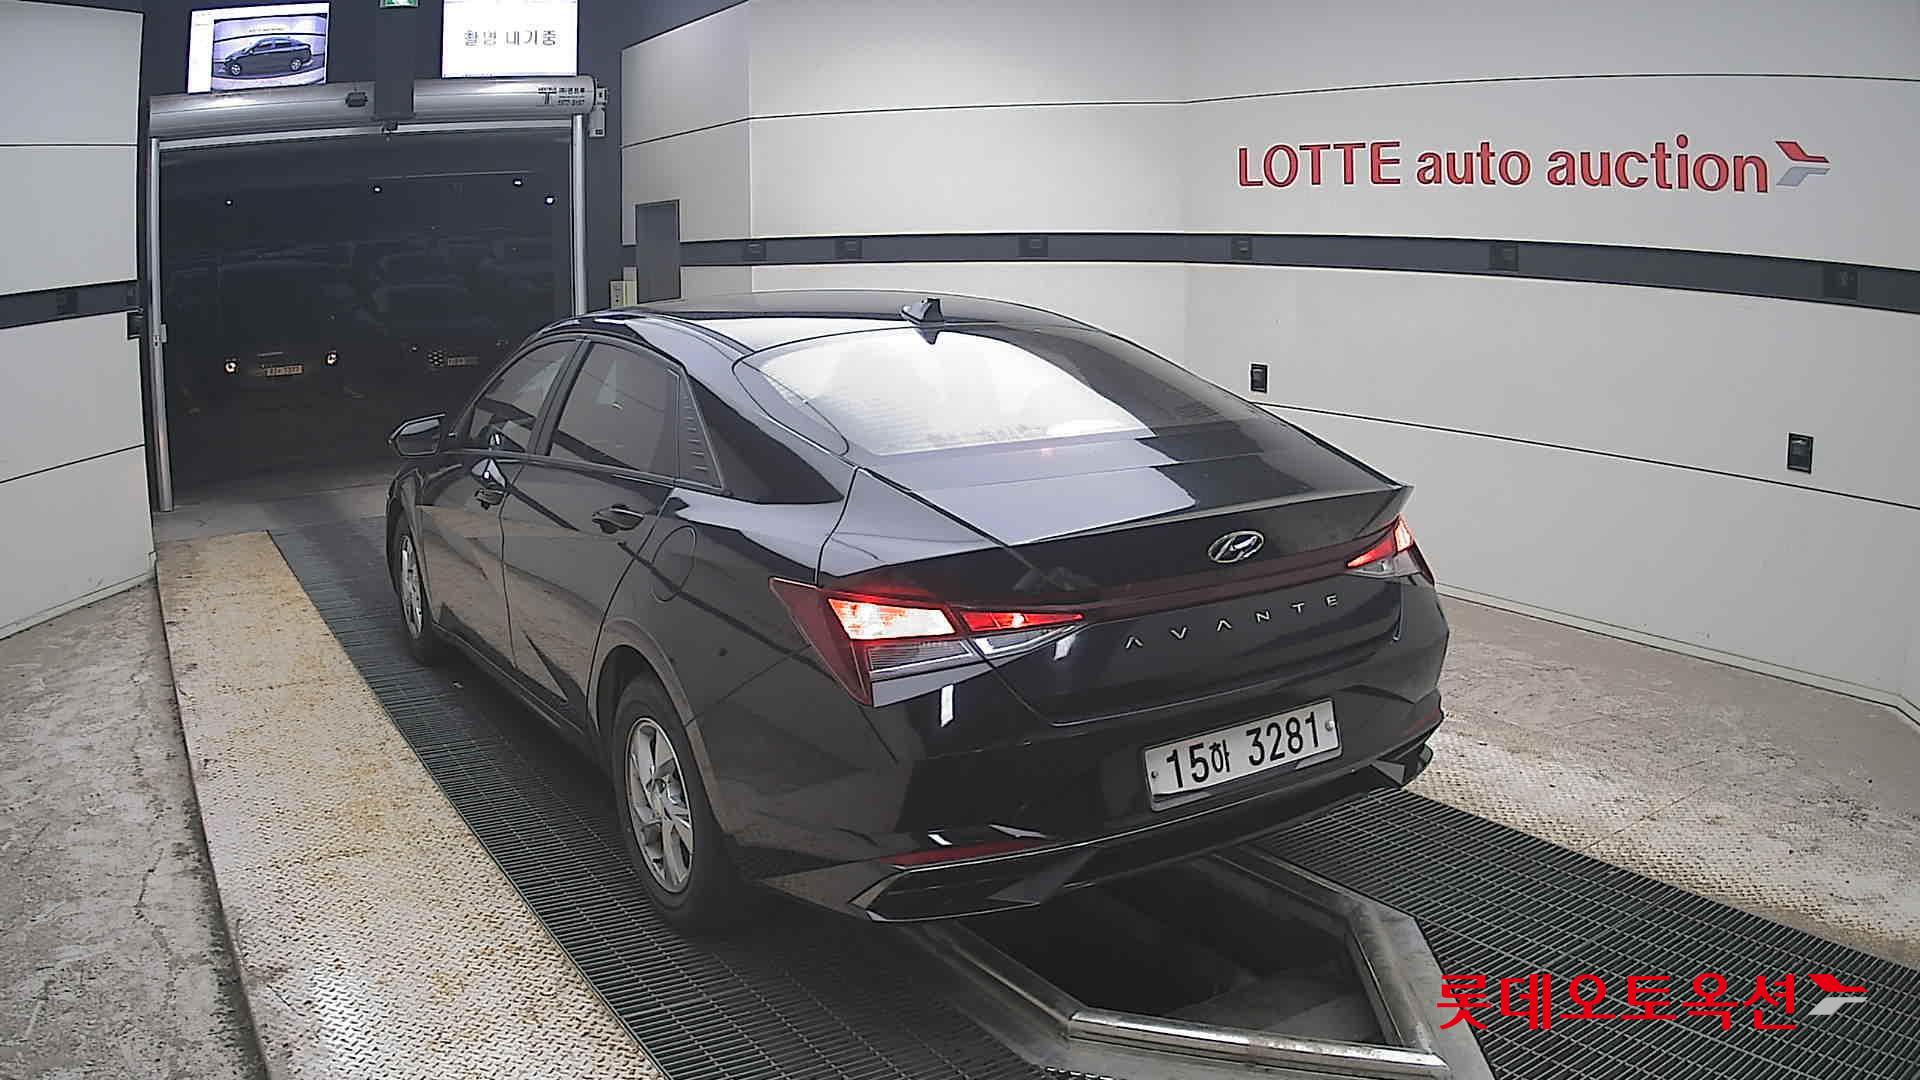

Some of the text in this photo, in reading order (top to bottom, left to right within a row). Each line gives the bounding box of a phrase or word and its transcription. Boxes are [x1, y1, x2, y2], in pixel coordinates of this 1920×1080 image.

[1238, 135, 1769, 194] LOTTE auto auction
[1124, 592, 1338, 650] AVANTE
[1166, 711, 1320, 789] 15하 3281
